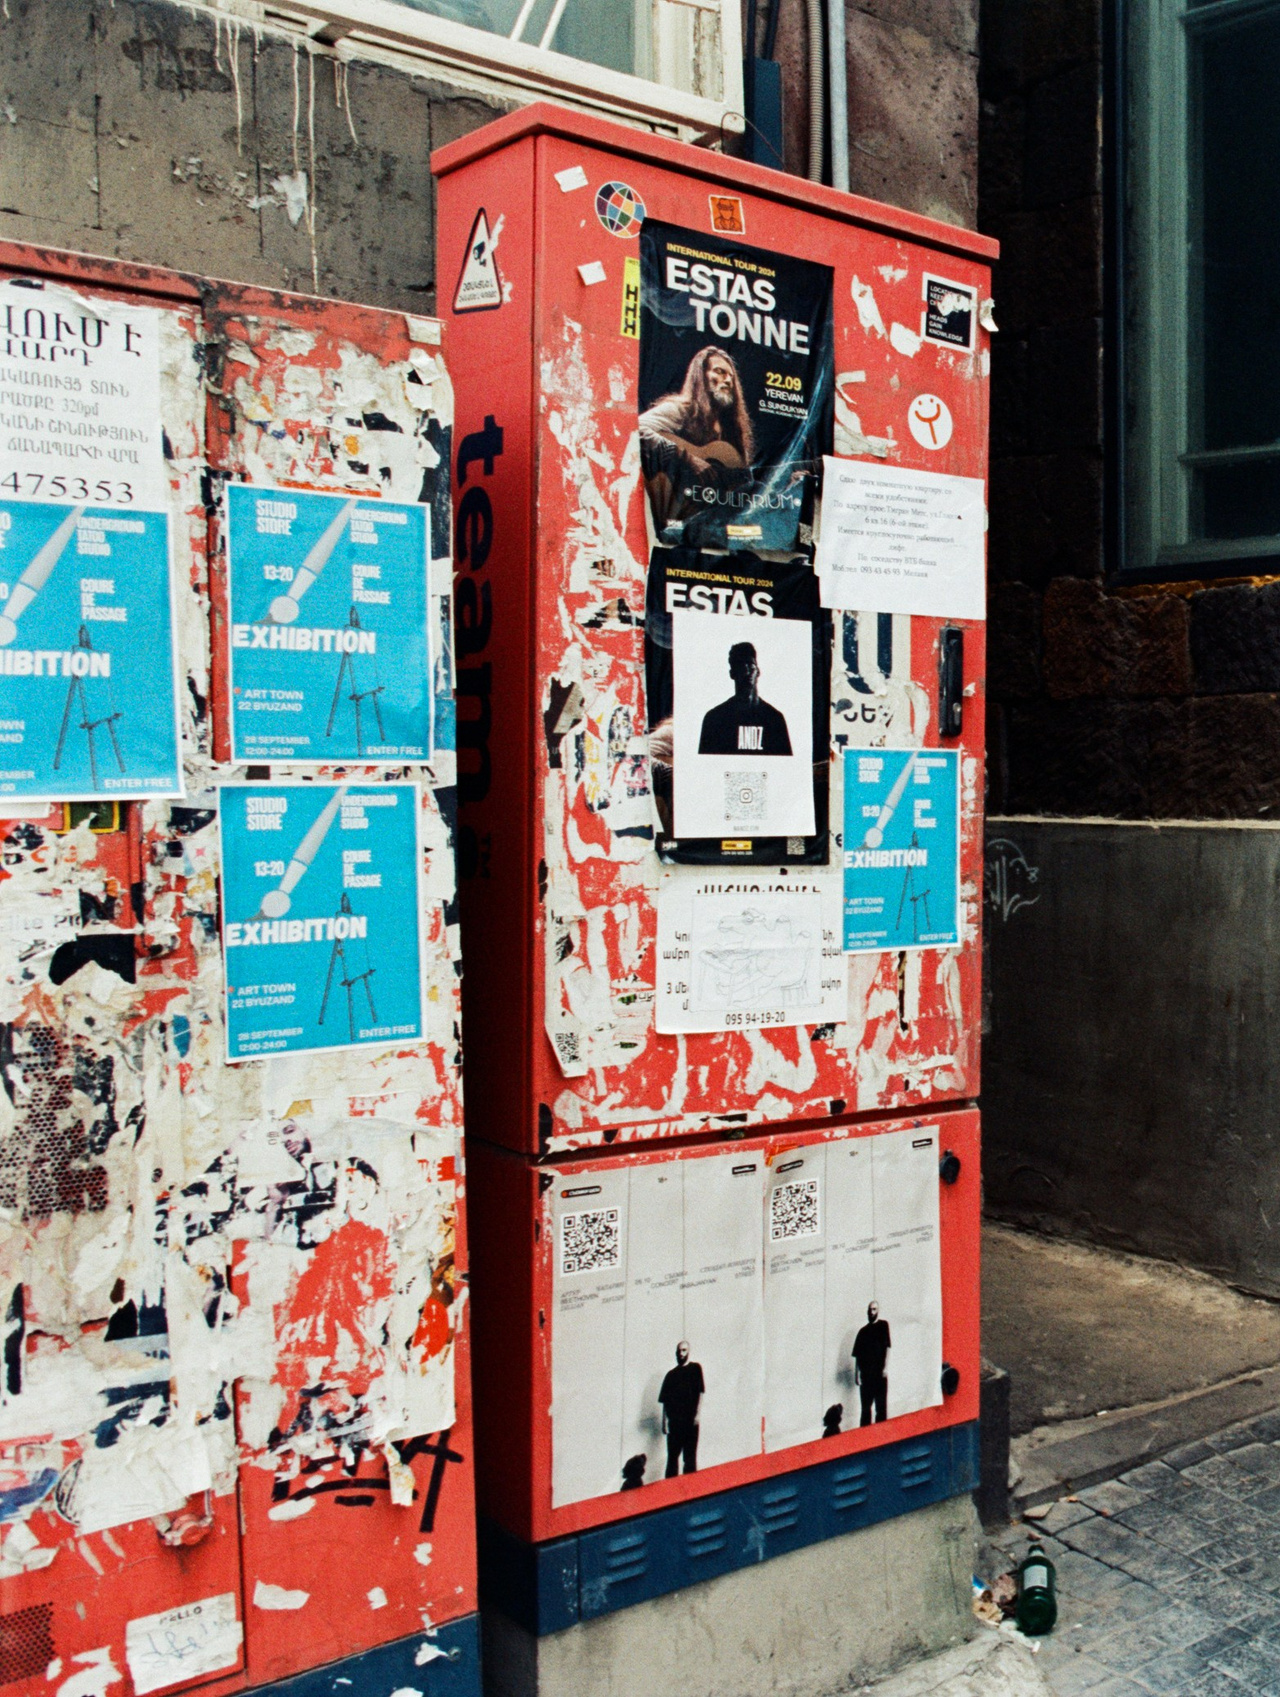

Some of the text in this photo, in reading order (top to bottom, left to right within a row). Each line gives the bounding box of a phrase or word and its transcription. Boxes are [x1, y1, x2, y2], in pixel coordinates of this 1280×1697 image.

[666, 243, 775, 277] INTERNATIONAL TOUR 2024
[666, 256, 776, 312] ESTAS
[689, 298, 811, 356] TONNE
[928, 328, 964, 343] KNOWLEDGE
[765, 371, 802, 392] 22.09
[765, 388, 804, 404] YEREVAN
[767, 401, 809, 416] SUNDUKYAN
[0, 471, 134, 504] 475353
[256, 500, 297, 519] STUDIO
[256, 518, 292, 536] STORE
[666, 568, 774, 588] INTERNATIONAL TOUR 2024
[666, 582, 774, 618] ESTAS
[232, 624, 376, 654] EXHIBITION
[244, 689, 304, 701] ART TOWN
[238, 701, 303, 713] 22 BYUZAND
[259, 736, 311, 747] SEPTEMBER
[367, 746, 424, 757] ENTER FREE
[104, 778, 173, 789] ENTER FREE
[246, 797, 287, 815] STUDIO
[247, 813, 283, 831] STORE
[844, 849, 928, 869] EXHIBITION
[226, 916, 368, 947] EXHIBITION
[237, 983, 296, 997] ART TOWN
[232, 995, 295, 1009] 22 BYUZAND
[725, 1012, 786, 1025] 095 94-19-20
[250, 1027, 304, 1041] SEPTEMBER
[359, 1024, 417, 1039] ENTER FREE
